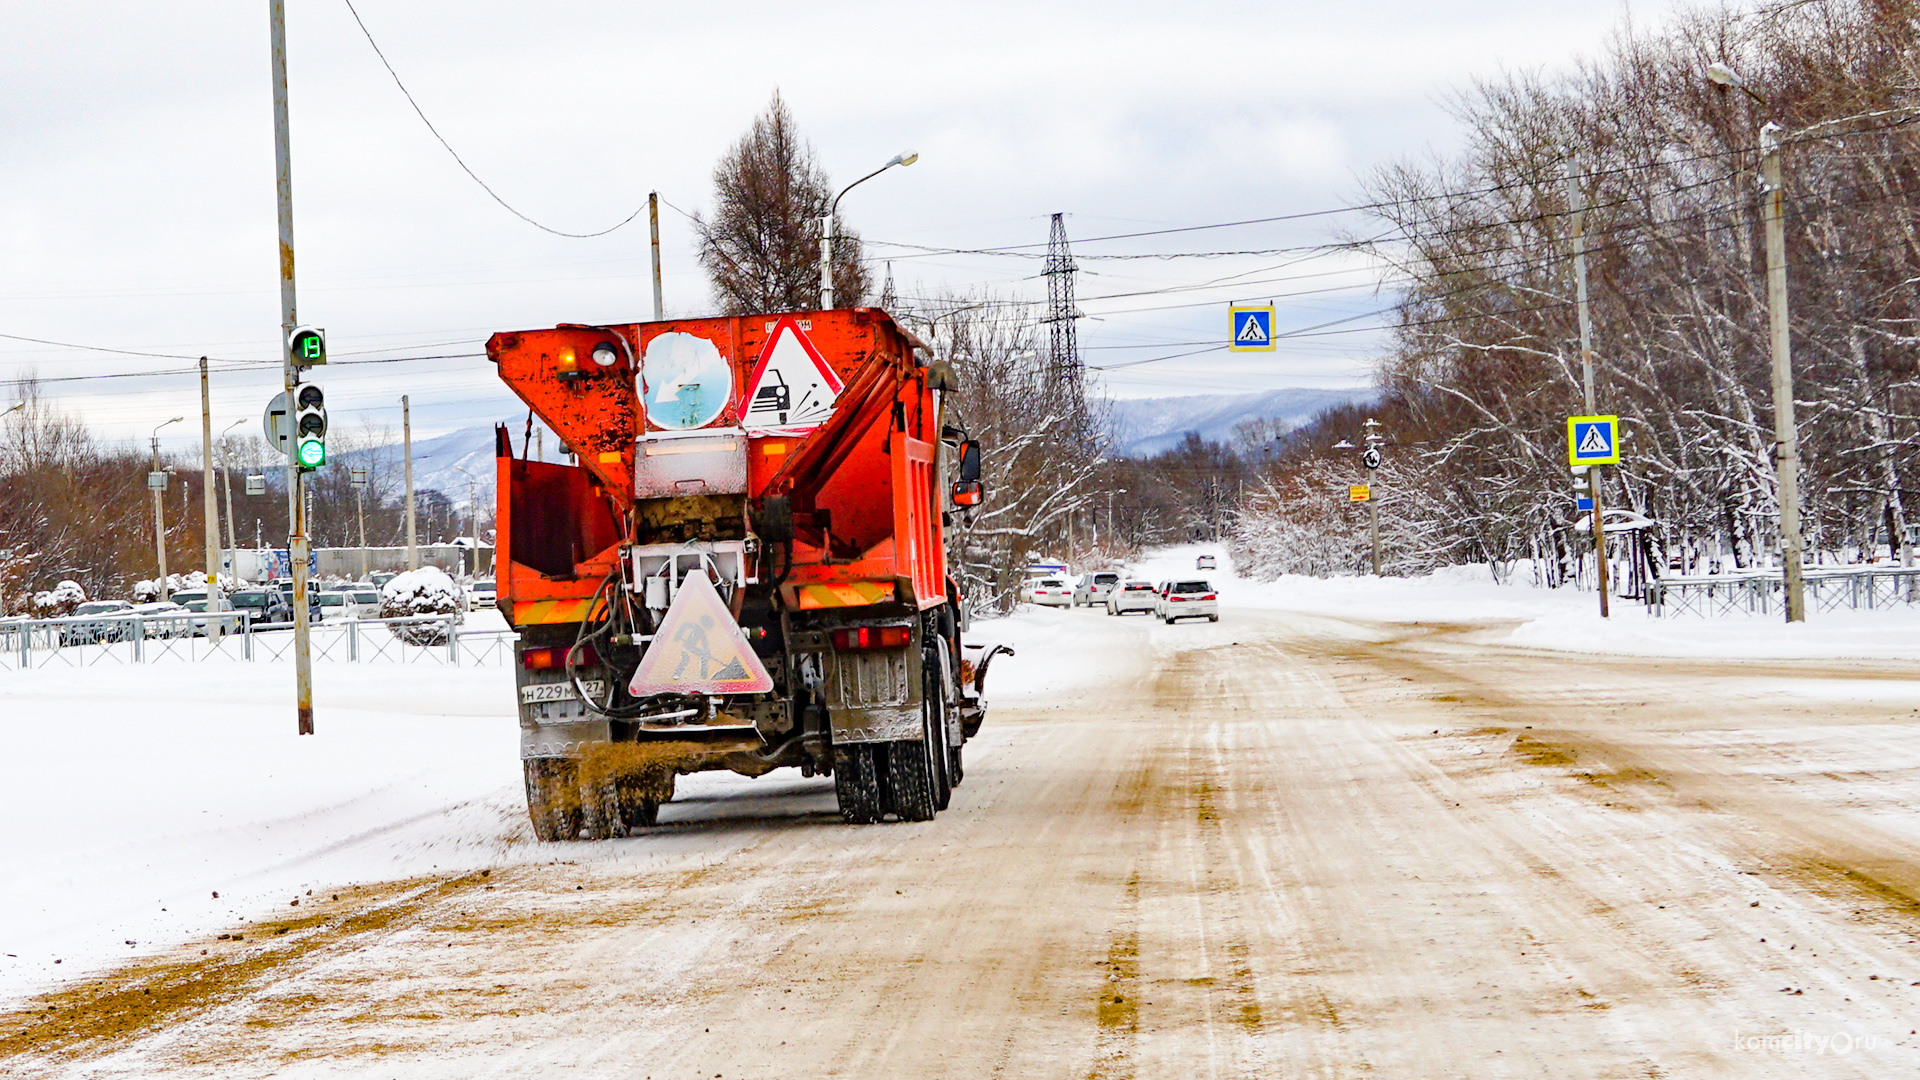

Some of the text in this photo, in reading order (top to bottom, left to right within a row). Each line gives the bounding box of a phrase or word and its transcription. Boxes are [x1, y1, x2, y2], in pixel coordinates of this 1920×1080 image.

[303, 336, 321, 358] 19
[526, 682, 599, 700] Н229М 27
